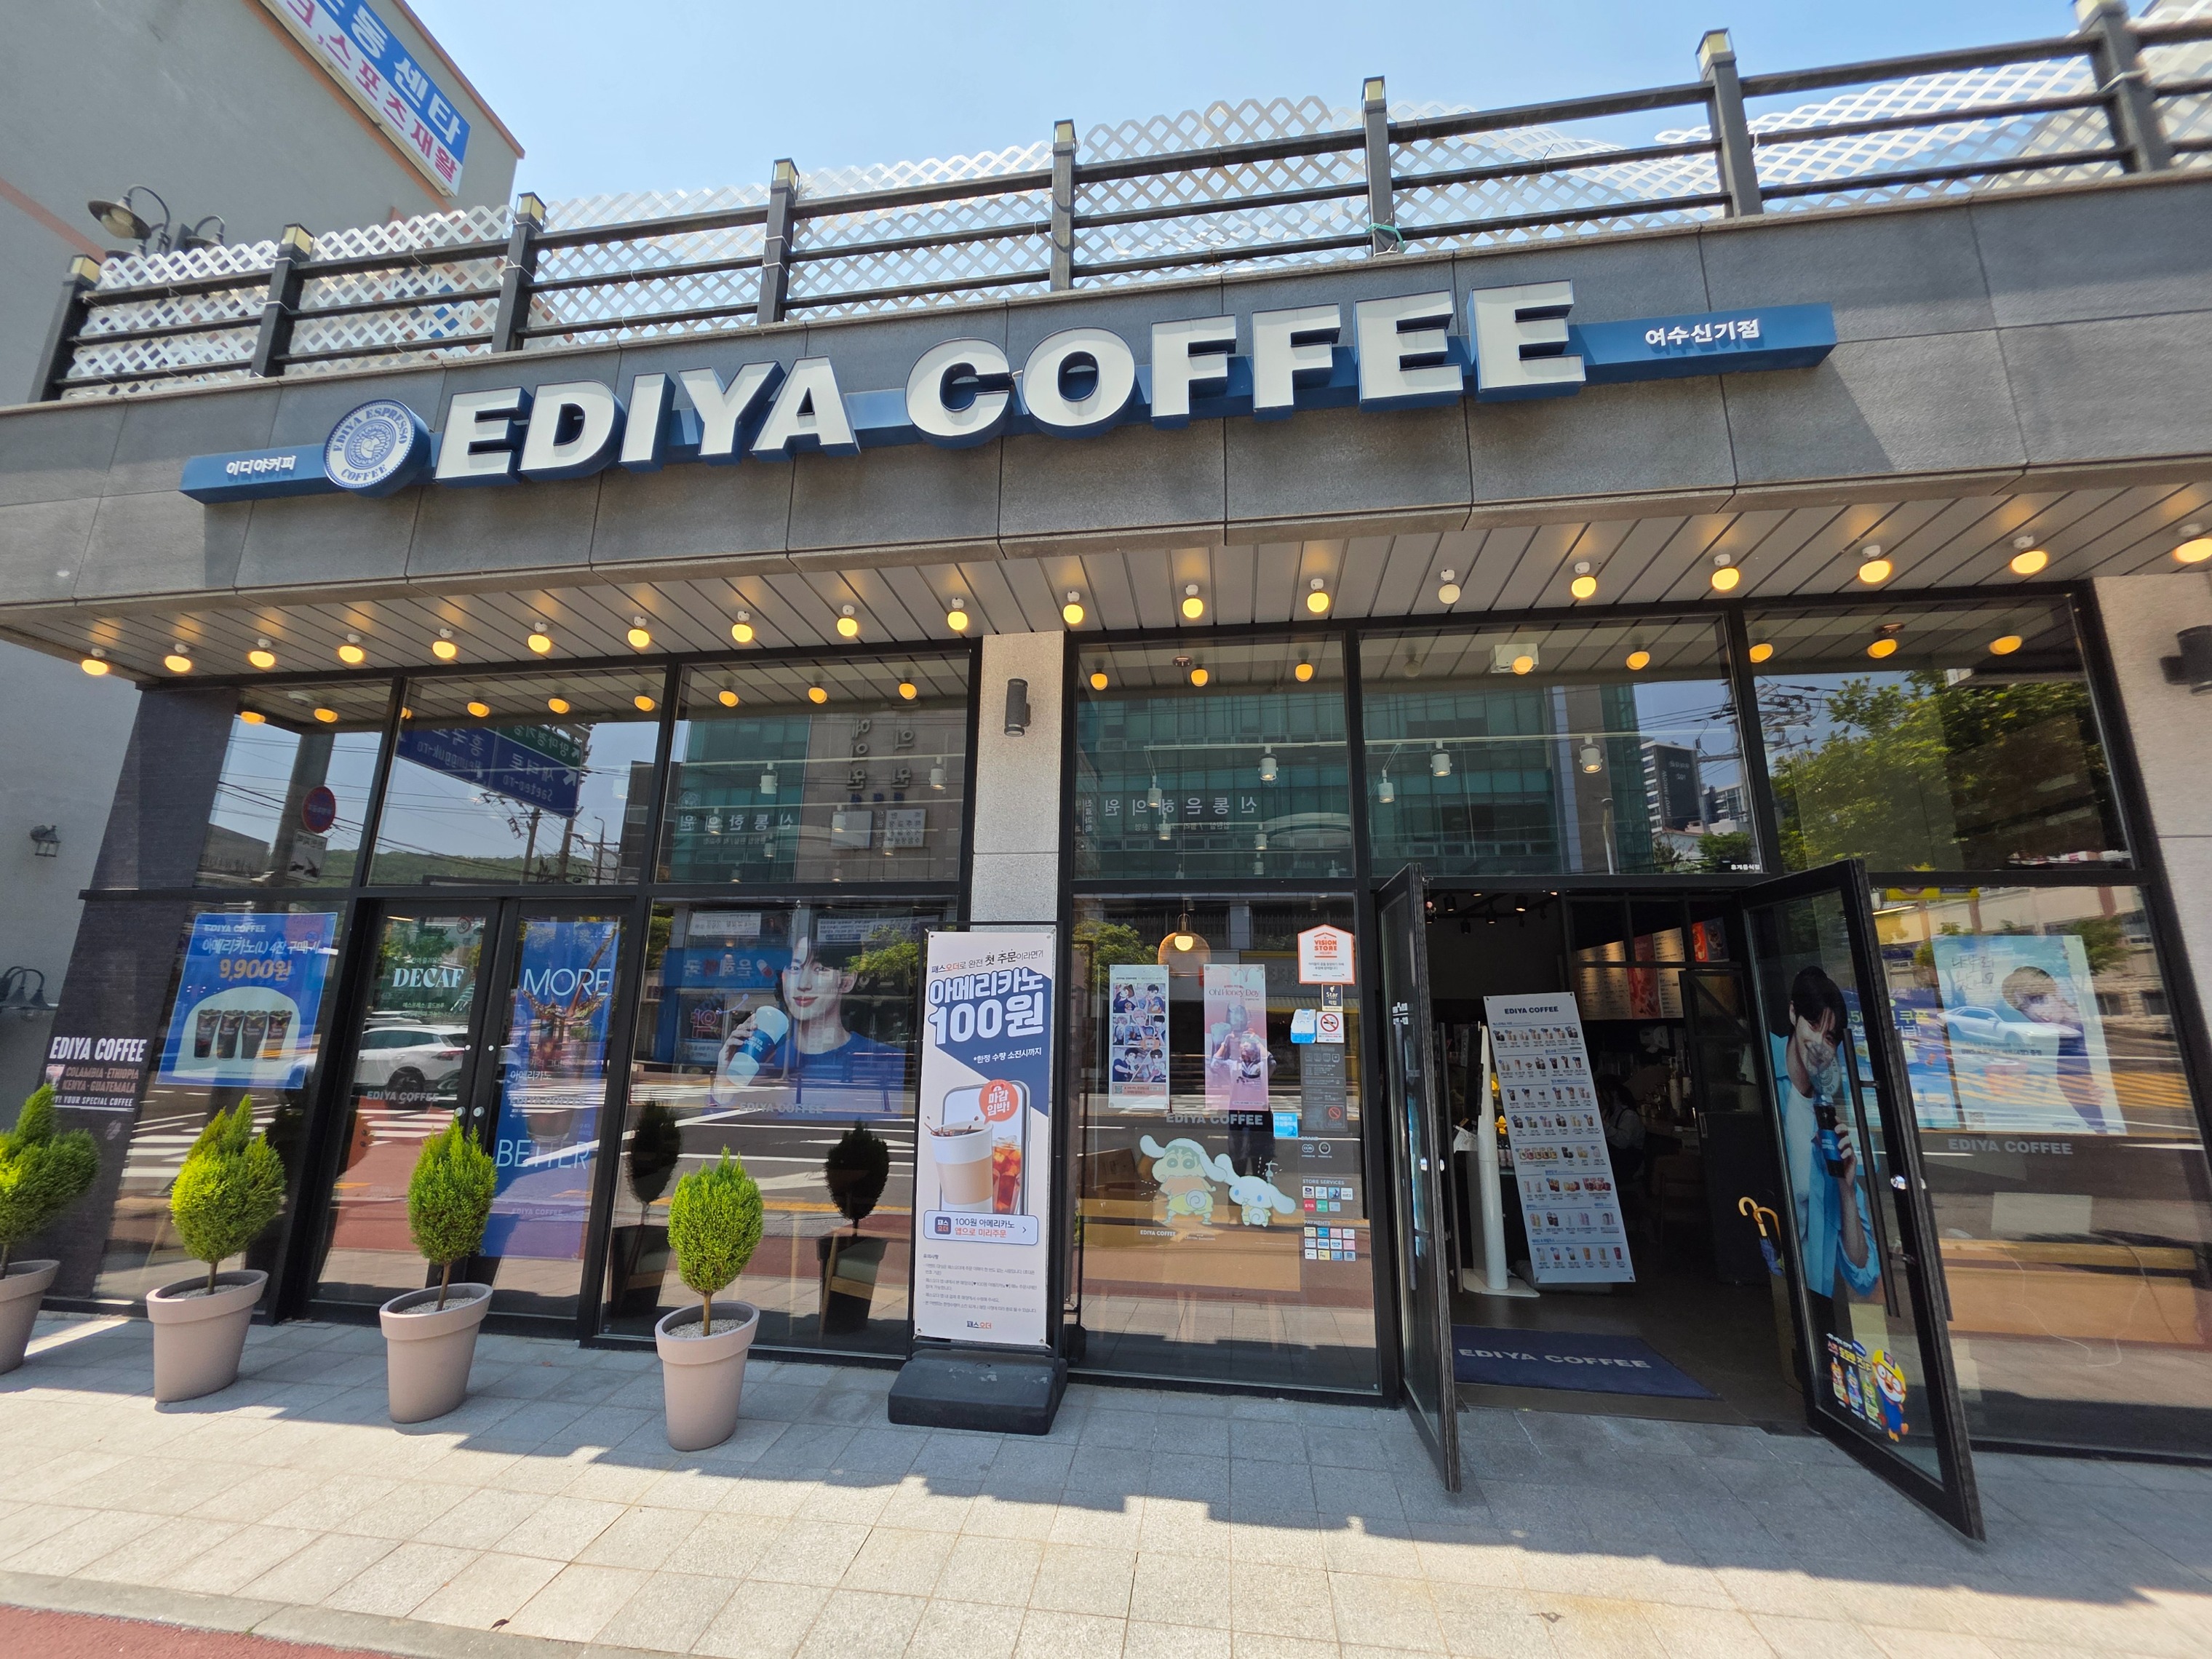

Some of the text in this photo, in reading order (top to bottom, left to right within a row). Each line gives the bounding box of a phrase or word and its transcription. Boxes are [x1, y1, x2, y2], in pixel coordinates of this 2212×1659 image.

[1644, 319, 1760, 347] 여수신기점
[434, 279, 1586, 486] EDIYA COFFEE
[333, 407, 408, 452] EDIYA ESPRESSO
[226, 455, 297, 476] 이디야커피
[341, 464, 387, 482] COFFEE
[204, 924, 266, 933] EDIYA COFFEE
[220, 959, 292, 982] 9,900원
[931, 961, 966, 974] 패스오더로
[968, 958, 983, 968] 완전
[985, 954, 995, 966] 첫
[391, 968, 465, 989] DECAF
[523, 968, 611, 996] MORE
[929, 966, 1044, 1004] 아메리카노
[928, 991, 1044, 1046] 100원
[1529, 1006, 1559, 1014] COFFEE
[49, 1036, 148, 1062] EDIYA COFFEE
[992, 1052, 1006, 1062] 수량
[1007, 1047, 1042, 1059] 소진시까지
[106, 1067, 139, 1080] ETHIOPIA
[62, 1080, 136, 1094] KENYA GUATEMALA
[63, 1096, 80, 1105] YOUR
[81, 1097, 108, 1105] SPECIAL
[109, 1097, 133, 1107] COFFEE
[366, 1091, 439, 1102] EDIYA COFFEE
[988, 1089, 1009, 1104] 마감
[739, 1102, 824, 1115] EDIYA COFFEE
[987, 1101, 1011, 1117] 임박!
[1166, 1114, 1264, 1126] EDIYA COFFEE
[496, 1139, 590, 1170] BETTER
[1948, 1138, 2073, 1155] EDIYA COFFEE
[955, 1218, 1015, 1229] 100원 아메리카노
[955, 1228, 1007, 1238] 앱으로 미리주문
[1458, 1348, 1652, 1369] EDIYA COFFEE
